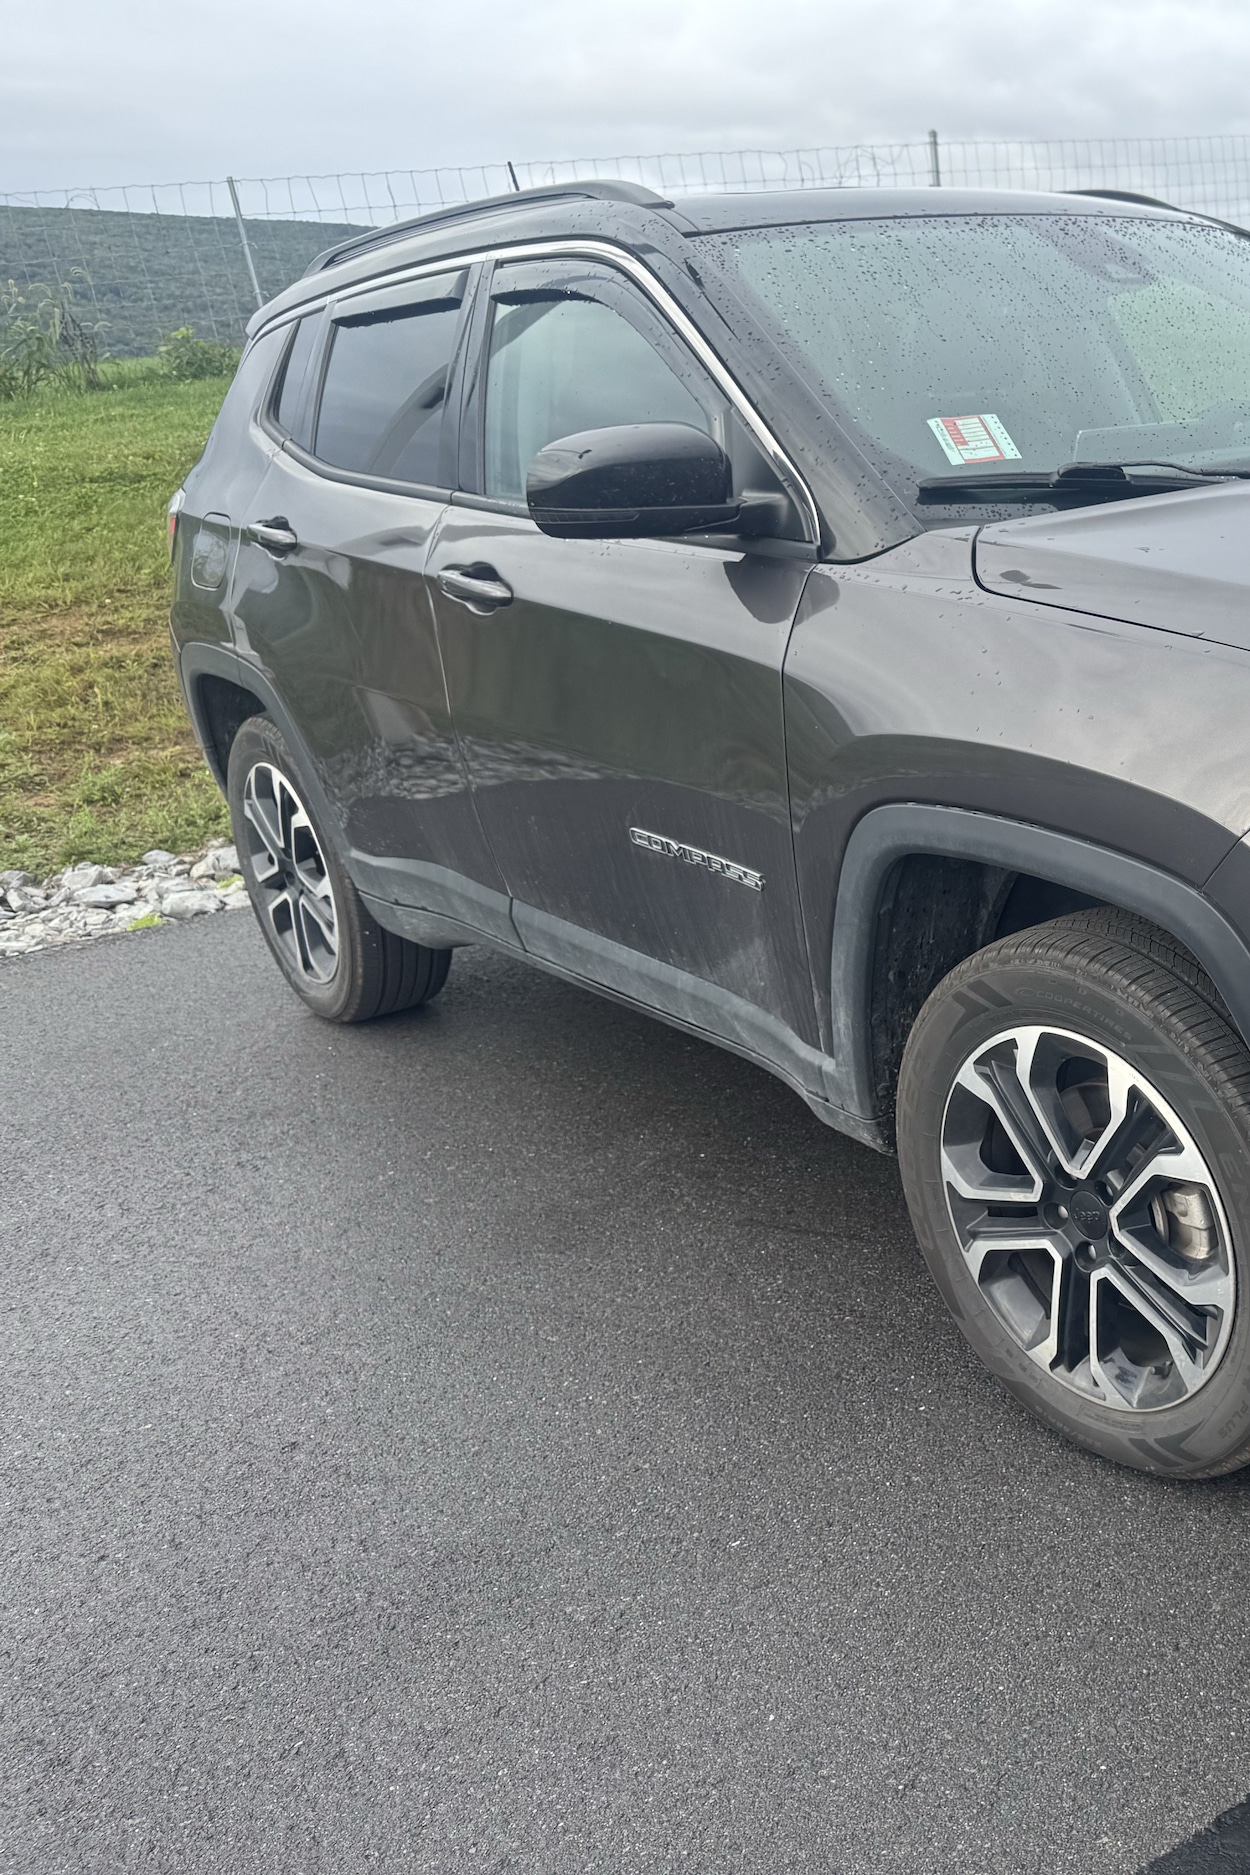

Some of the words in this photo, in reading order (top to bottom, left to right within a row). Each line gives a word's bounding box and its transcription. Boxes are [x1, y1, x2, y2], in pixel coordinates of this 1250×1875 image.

[629, 827, 766, 891] COMPASS
[1073, 1207, 1100, 1223] Jeep
[1217, 1399, 1249, 1439] PLUS
